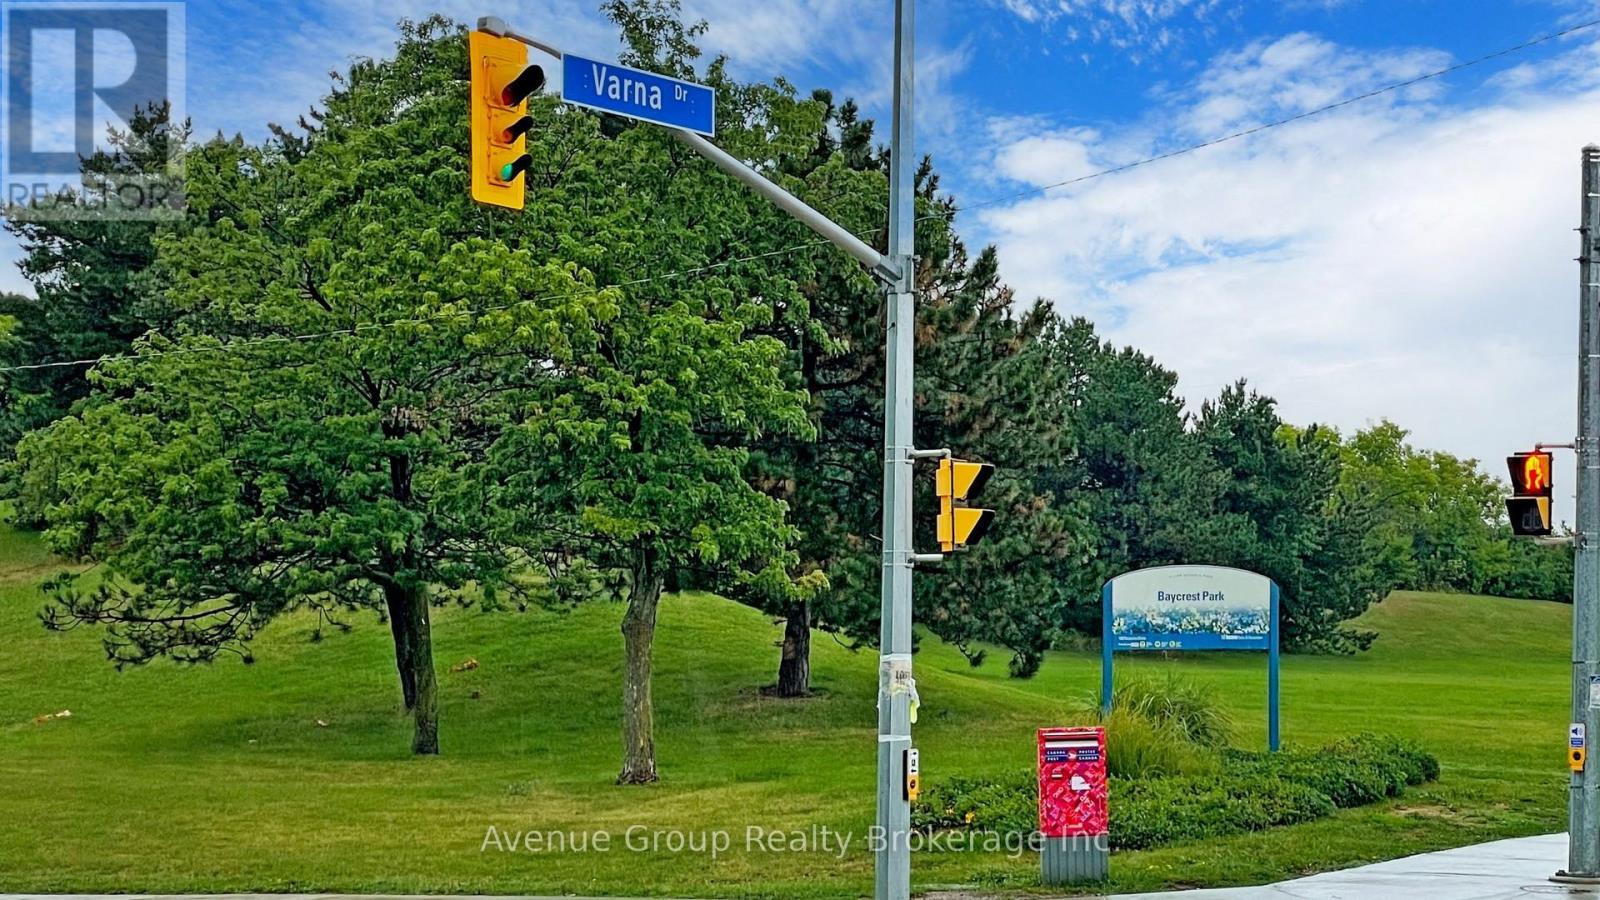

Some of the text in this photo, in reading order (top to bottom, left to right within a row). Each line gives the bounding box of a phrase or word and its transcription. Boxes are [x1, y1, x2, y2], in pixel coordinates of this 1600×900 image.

[592, 63, 688, 110] Varna Dr
[1157, 590, 1225, 603] Baycrest Park
